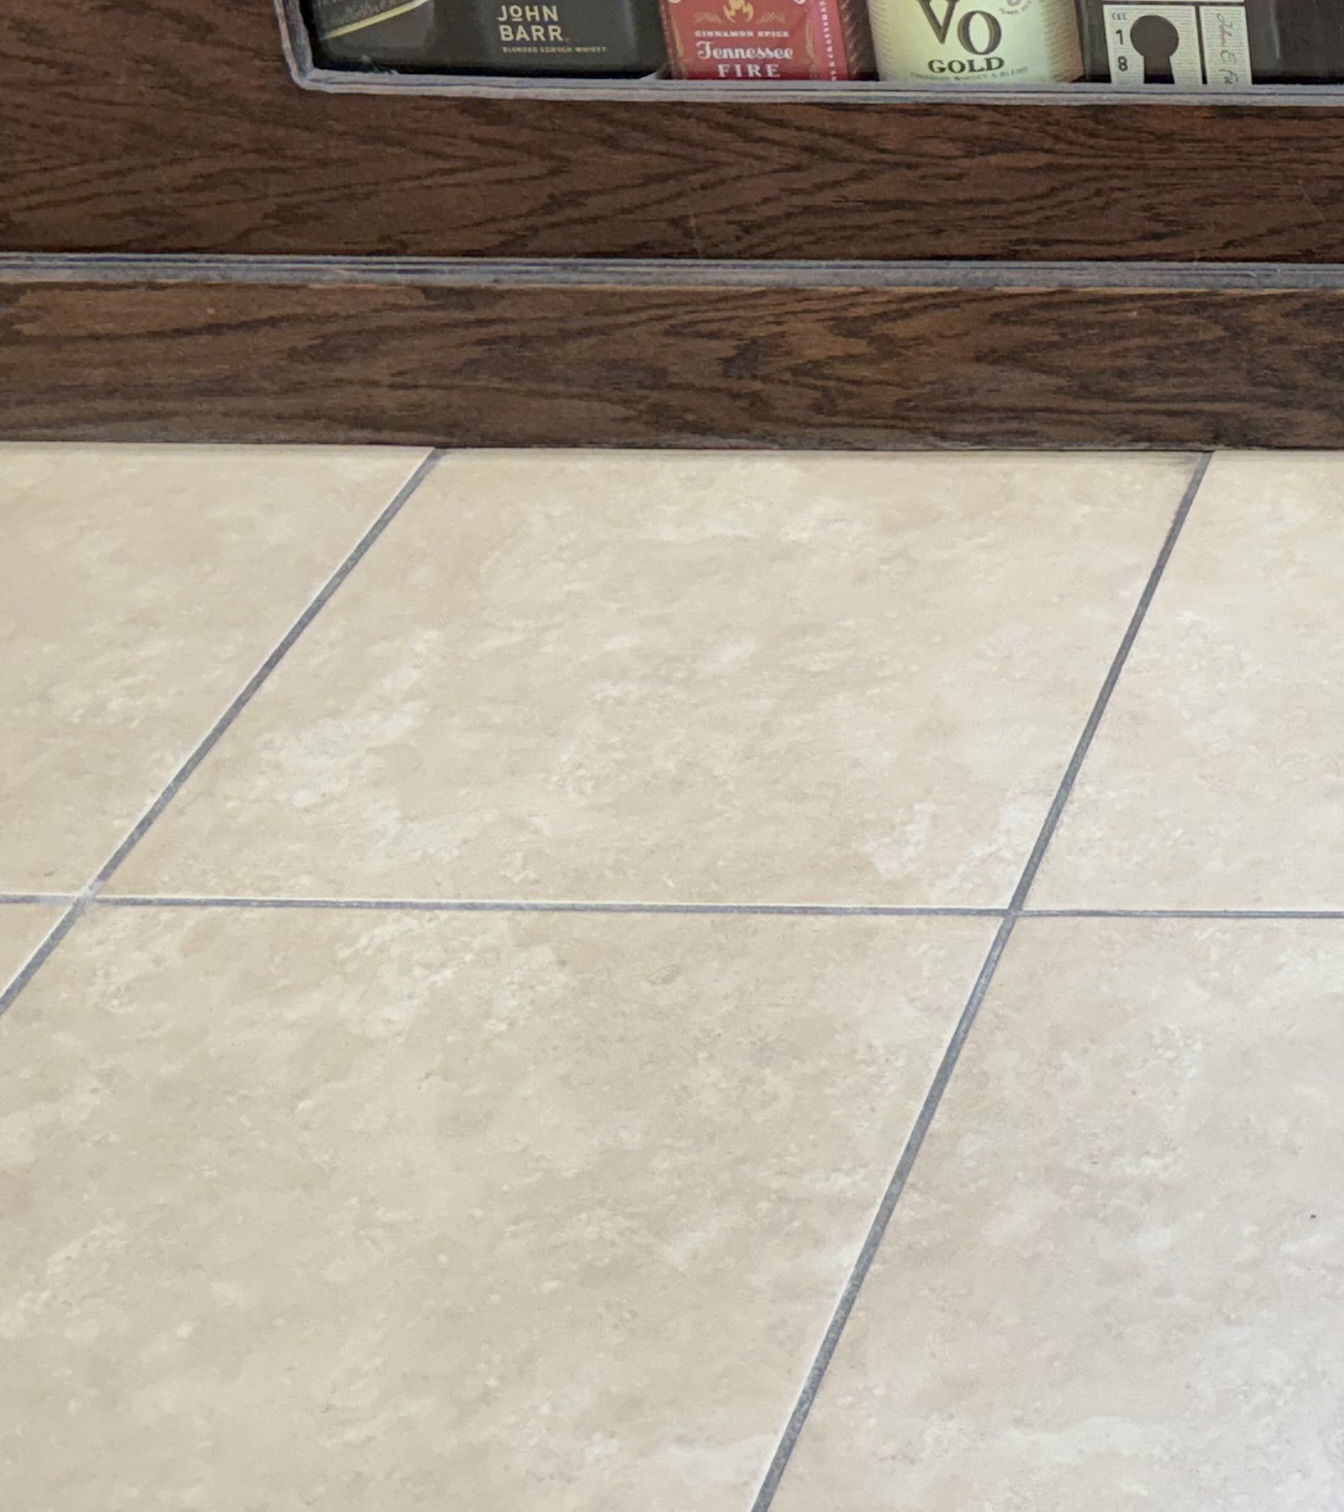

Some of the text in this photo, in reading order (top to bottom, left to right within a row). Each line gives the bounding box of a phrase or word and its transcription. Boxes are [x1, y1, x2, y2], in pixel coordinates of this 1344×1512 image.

[496, 4, 559, 22] JOHN
[498, 24, 564, 42] BARR
[694, 40, 794, 60] Tennessee
[717, 63, 781, 78] FIRE
[927, 56, 1005, 74] GOLD
